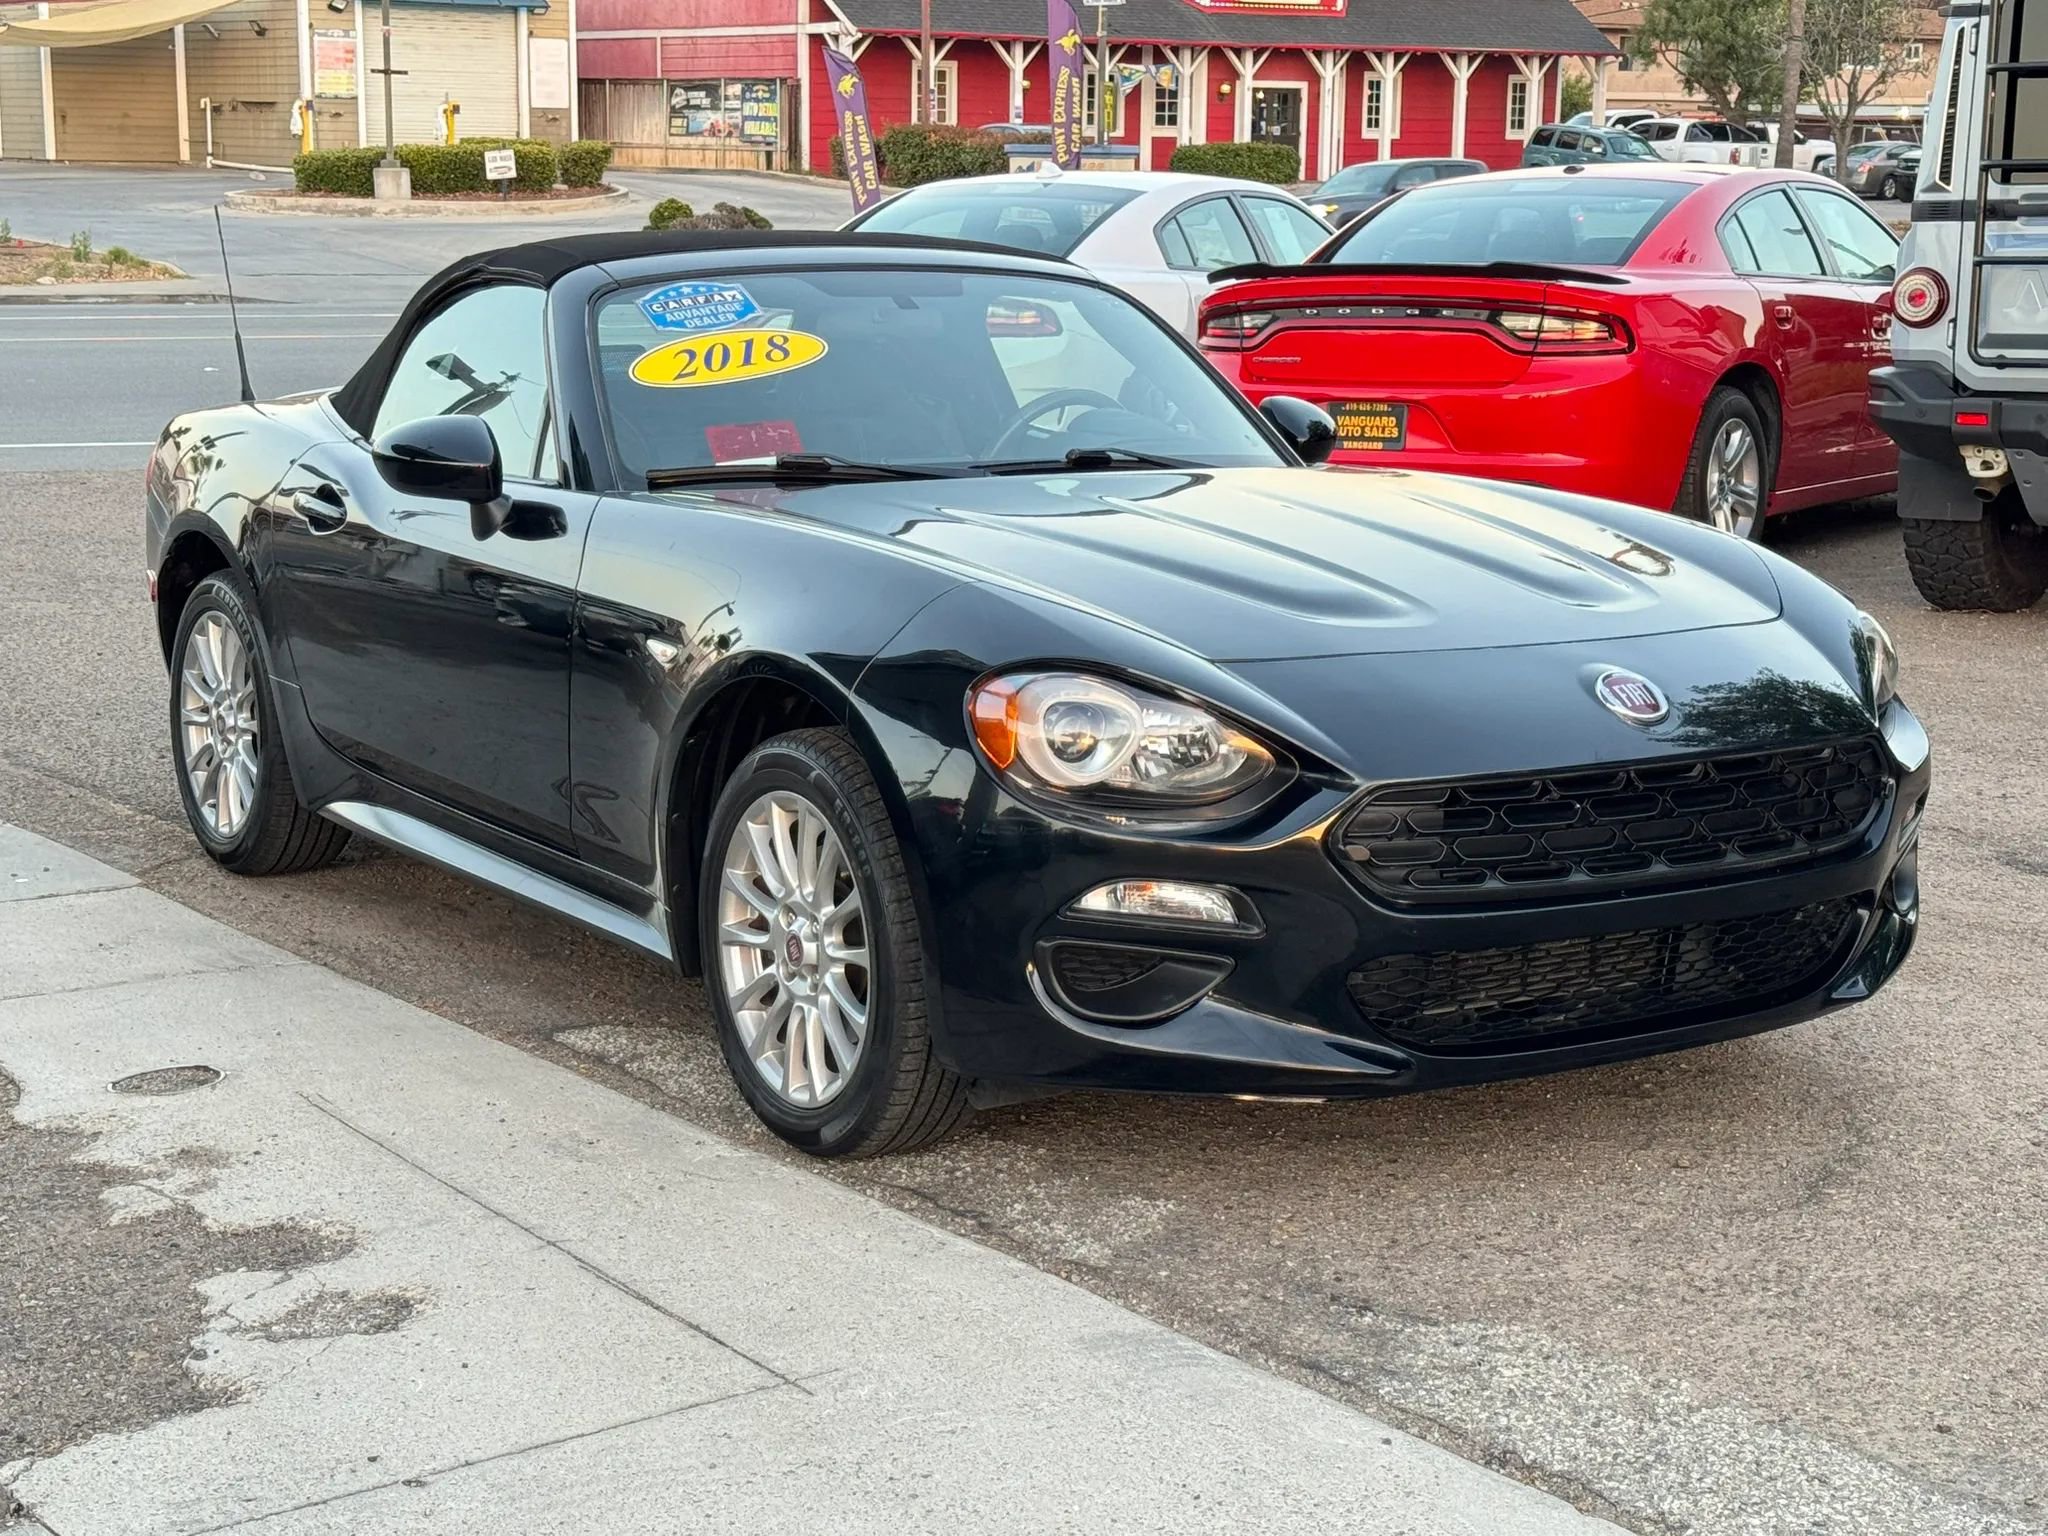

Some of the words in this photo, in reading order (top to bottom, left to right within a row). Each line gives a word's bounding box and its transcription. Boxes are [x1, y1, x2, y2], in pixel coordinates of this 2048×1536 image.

[1053, 65, 1071, 124] EXPRESS
[844, 110, 858, 168] EXPRESS
[1054, 128, 1069, 165] PONY
[1071, 123, 1081, 153] CAR
[851, 169, 868, 206] PONY
[863, 160, 877, 189] CAR
[651, 290, 741, 313] CARFAX
[665, 302, 745, 322] ADVANTAGE
[1305, 308, 1456, 316] DODGE
[683, 312, 739, 328] DEALER
[671, 334, 791, 382] 2018
[1336, 415, 1397, 427] VANGUARD
[1364, 427, 1399, 438] SALES
[1343, 441, 1384, 450] VANGUARD
[1611, 682, 1656, 708] FIAT
